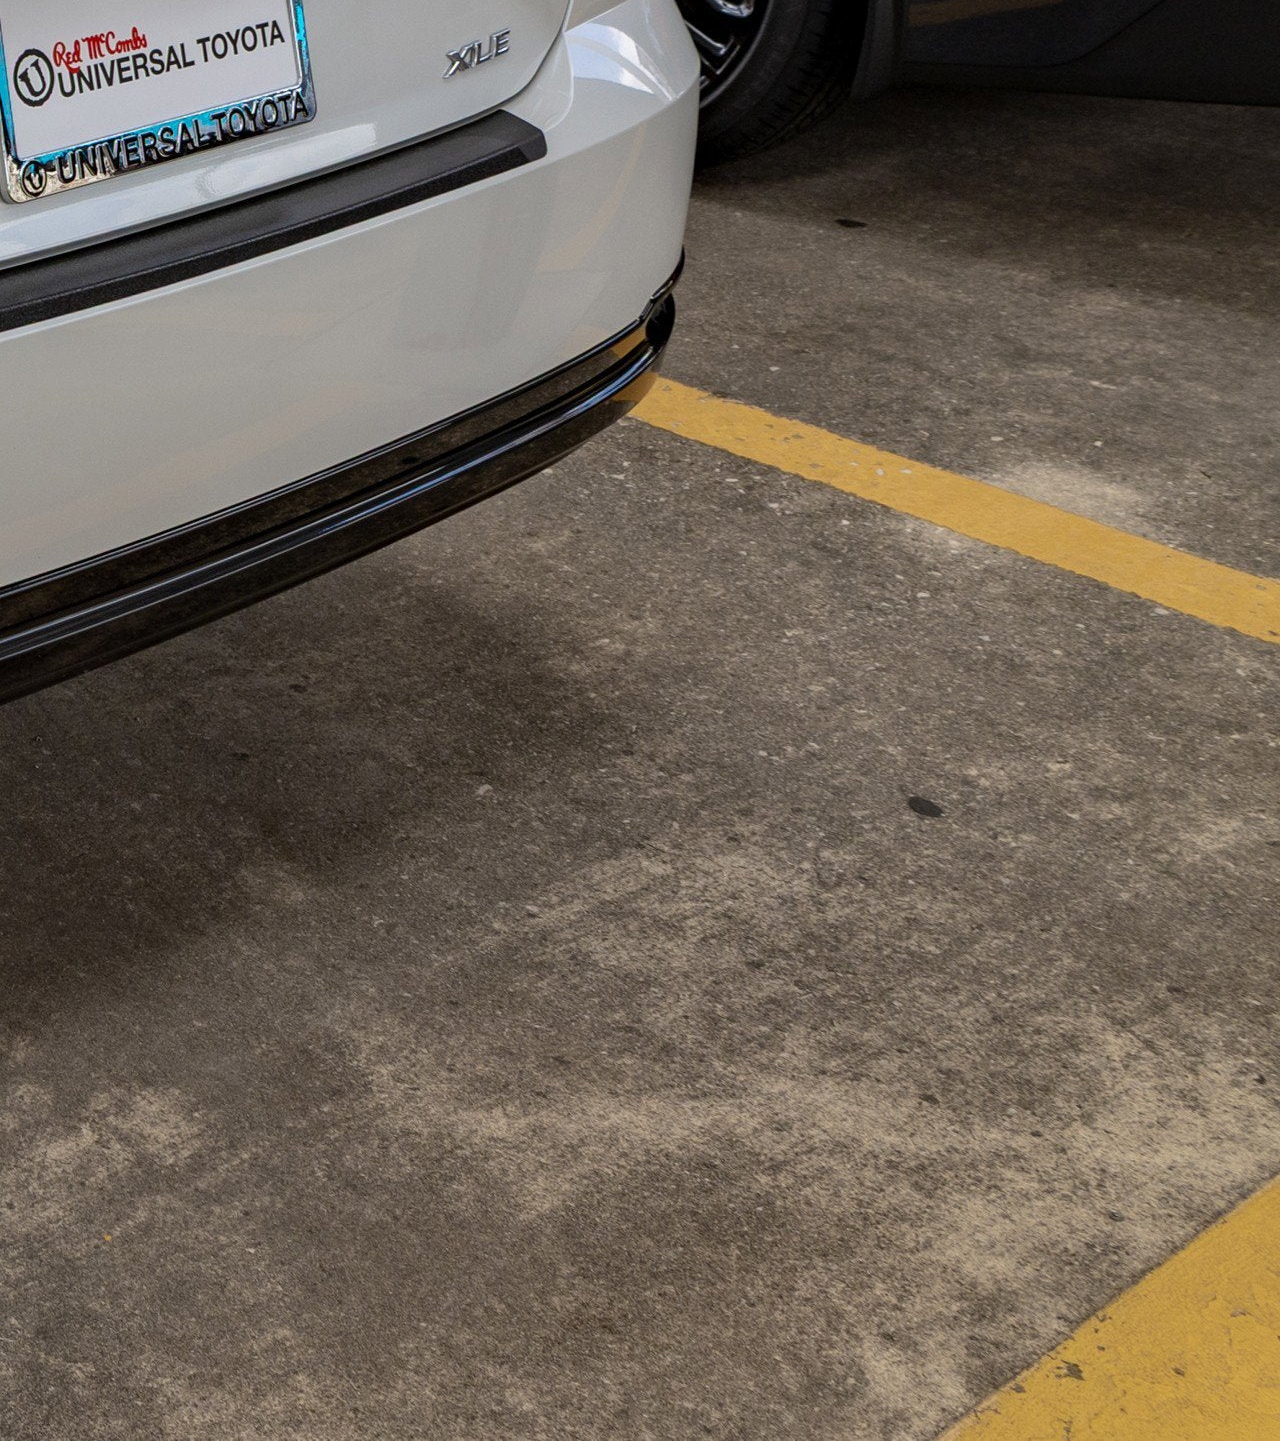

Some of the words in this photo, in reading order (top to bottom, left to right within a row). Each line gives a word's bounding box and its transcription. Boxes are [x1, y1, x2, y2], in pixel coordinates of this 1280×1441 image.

[53, 41, 83, 74] Red
[81, 26, 148, 60] McCombs
[58, 42, 195, 98] UNIVERSAL
[196, 19, 286, 63] TOYOTA
[442, 27, 512, 79] XLE
[55, 119, 213, 185] UNIVERSAL
[209, 91, 310, 142] TOYOTA
